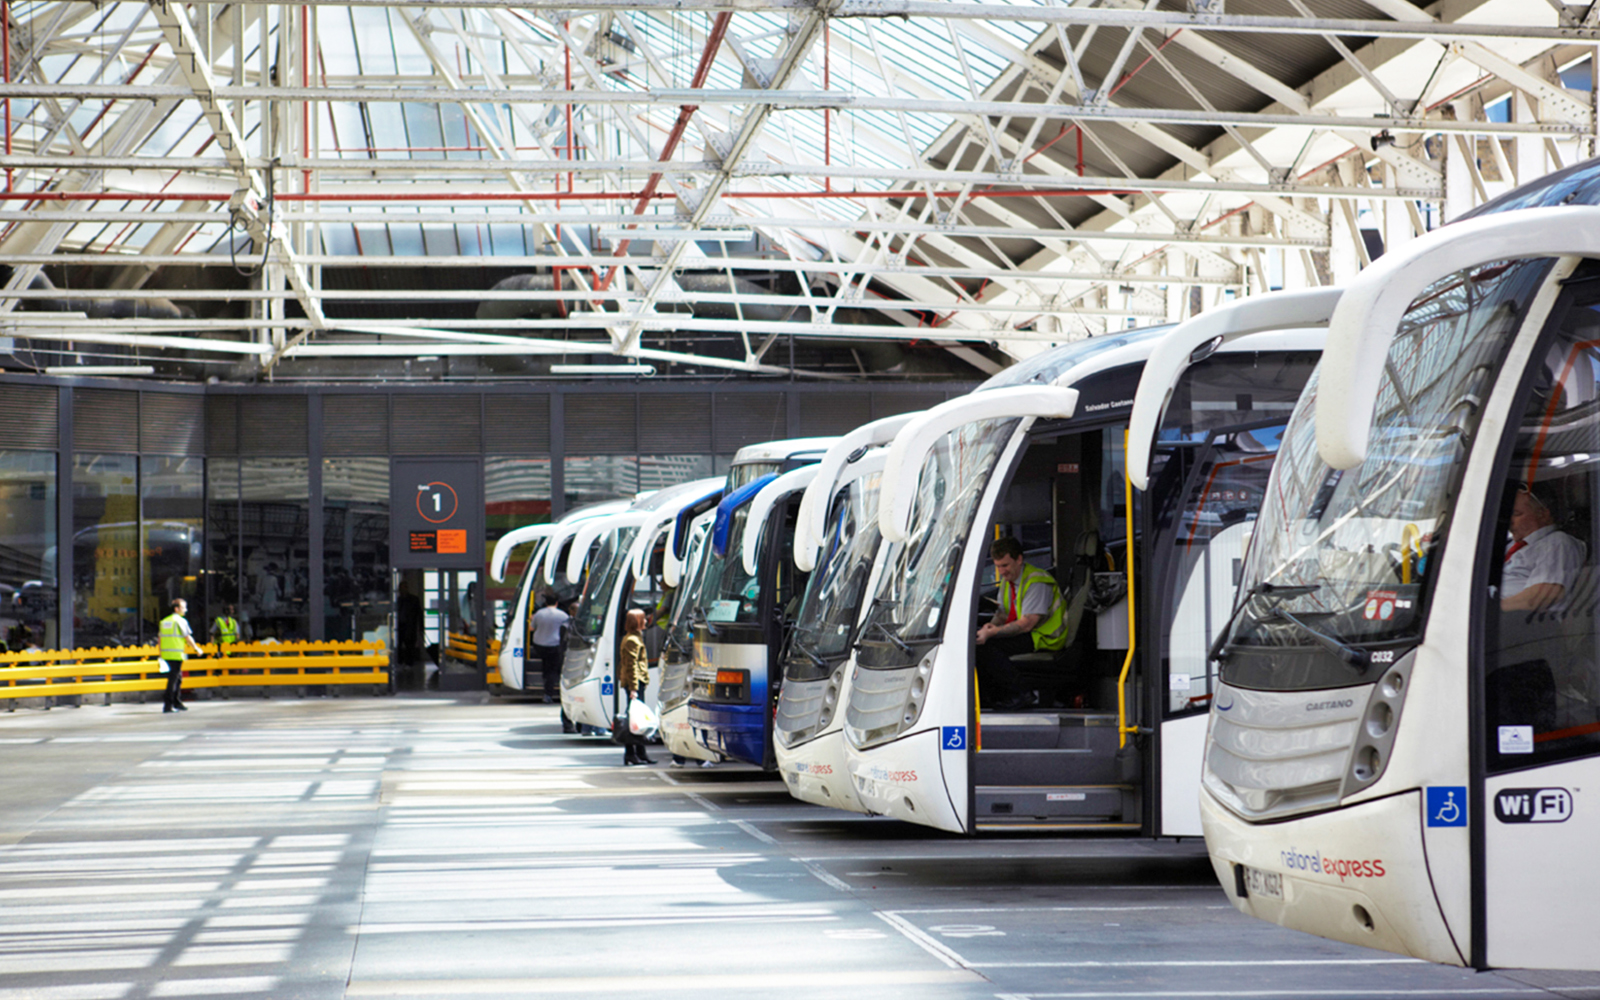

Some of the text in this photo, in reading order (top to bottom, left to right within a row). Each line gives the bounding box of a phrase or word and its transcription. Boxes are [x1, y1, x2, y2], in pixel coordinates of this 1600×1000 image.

[432, 492, 440, 512] 1
[1306, 699, 1353, 711] CAETANO
[1281, 846, 1386, 883] national express
